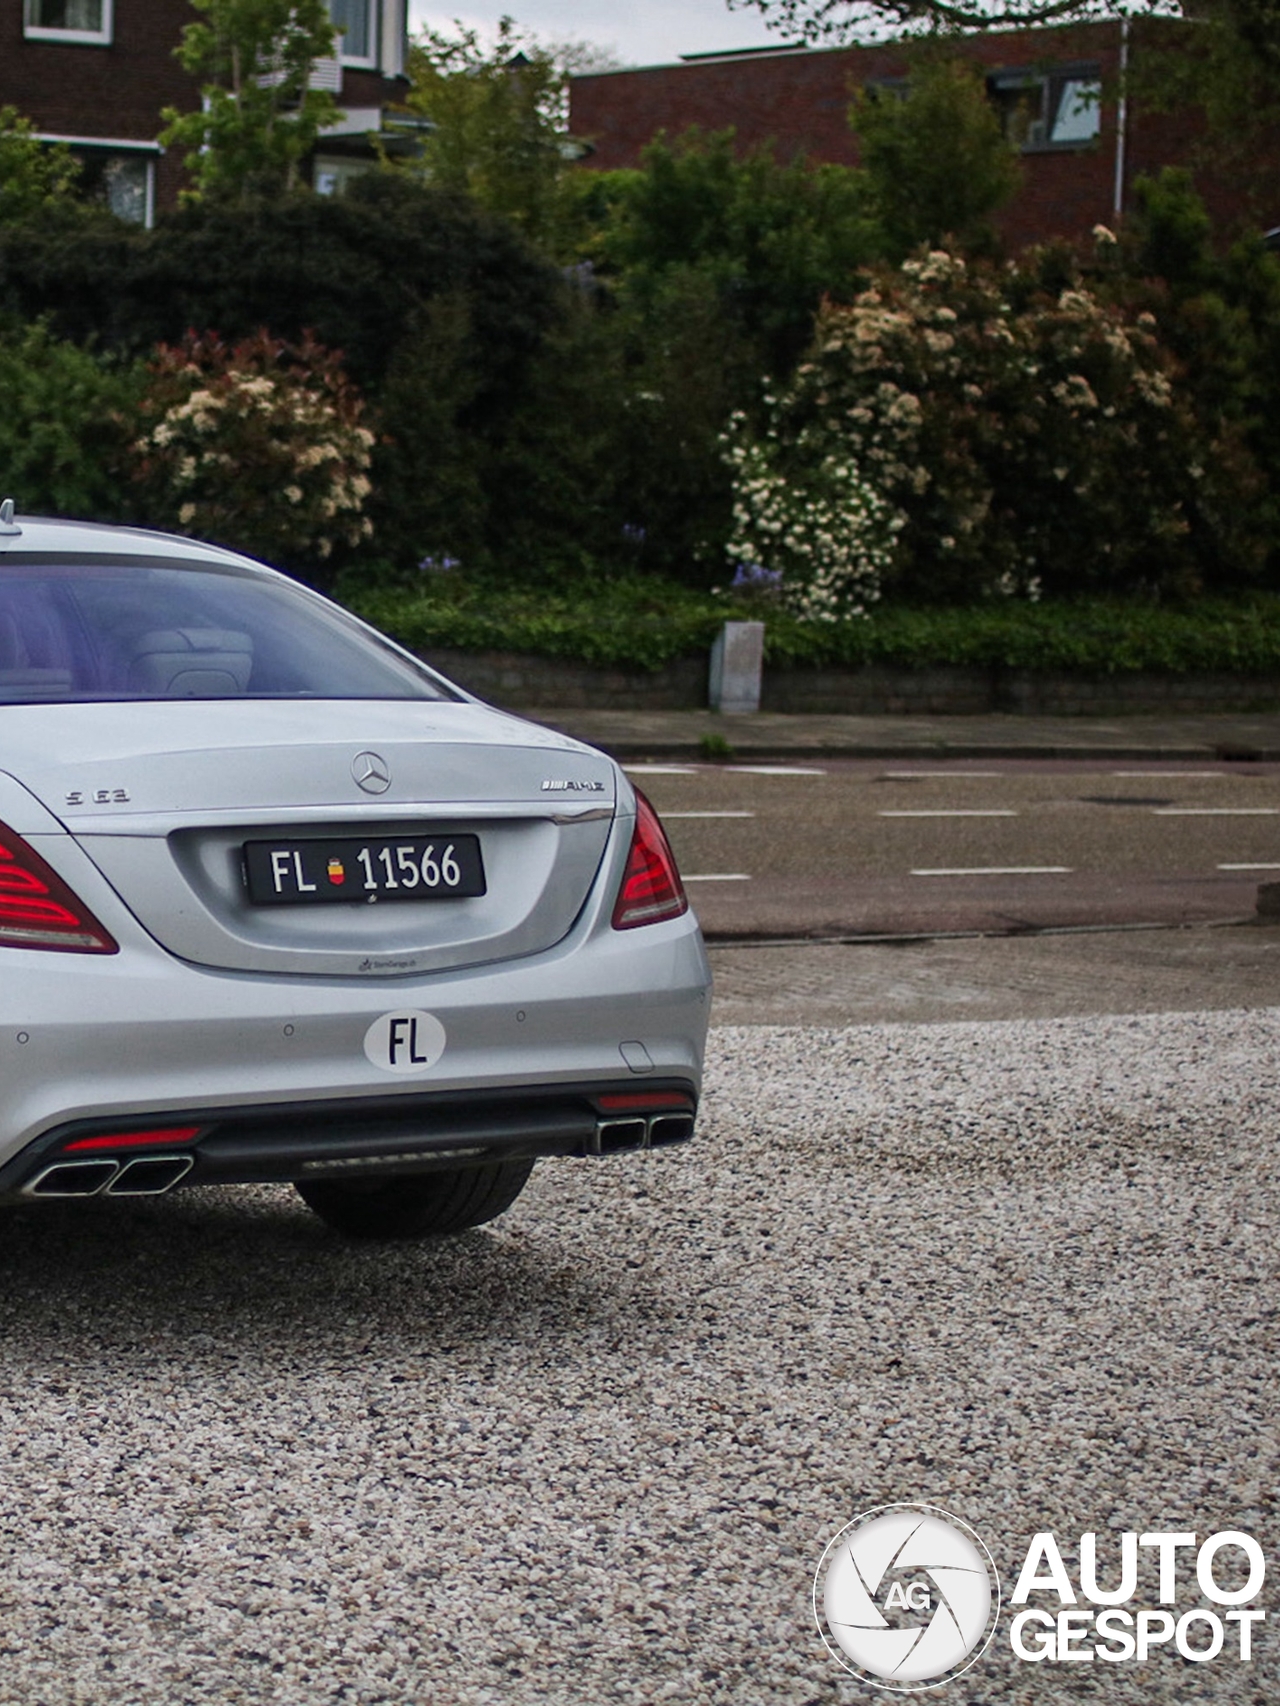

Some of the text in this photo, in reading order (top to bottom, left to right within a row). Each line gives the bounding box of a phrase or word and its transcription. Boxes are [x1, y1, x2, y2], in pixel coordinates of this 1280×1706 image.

[65, 788, 131, 806] S 63
[563, 780, 605, 791] AMG
[271, 851, 317, 892] FL
[357, 845, 461, 890] 11566
[389, 1018, 428, 1065] FL
